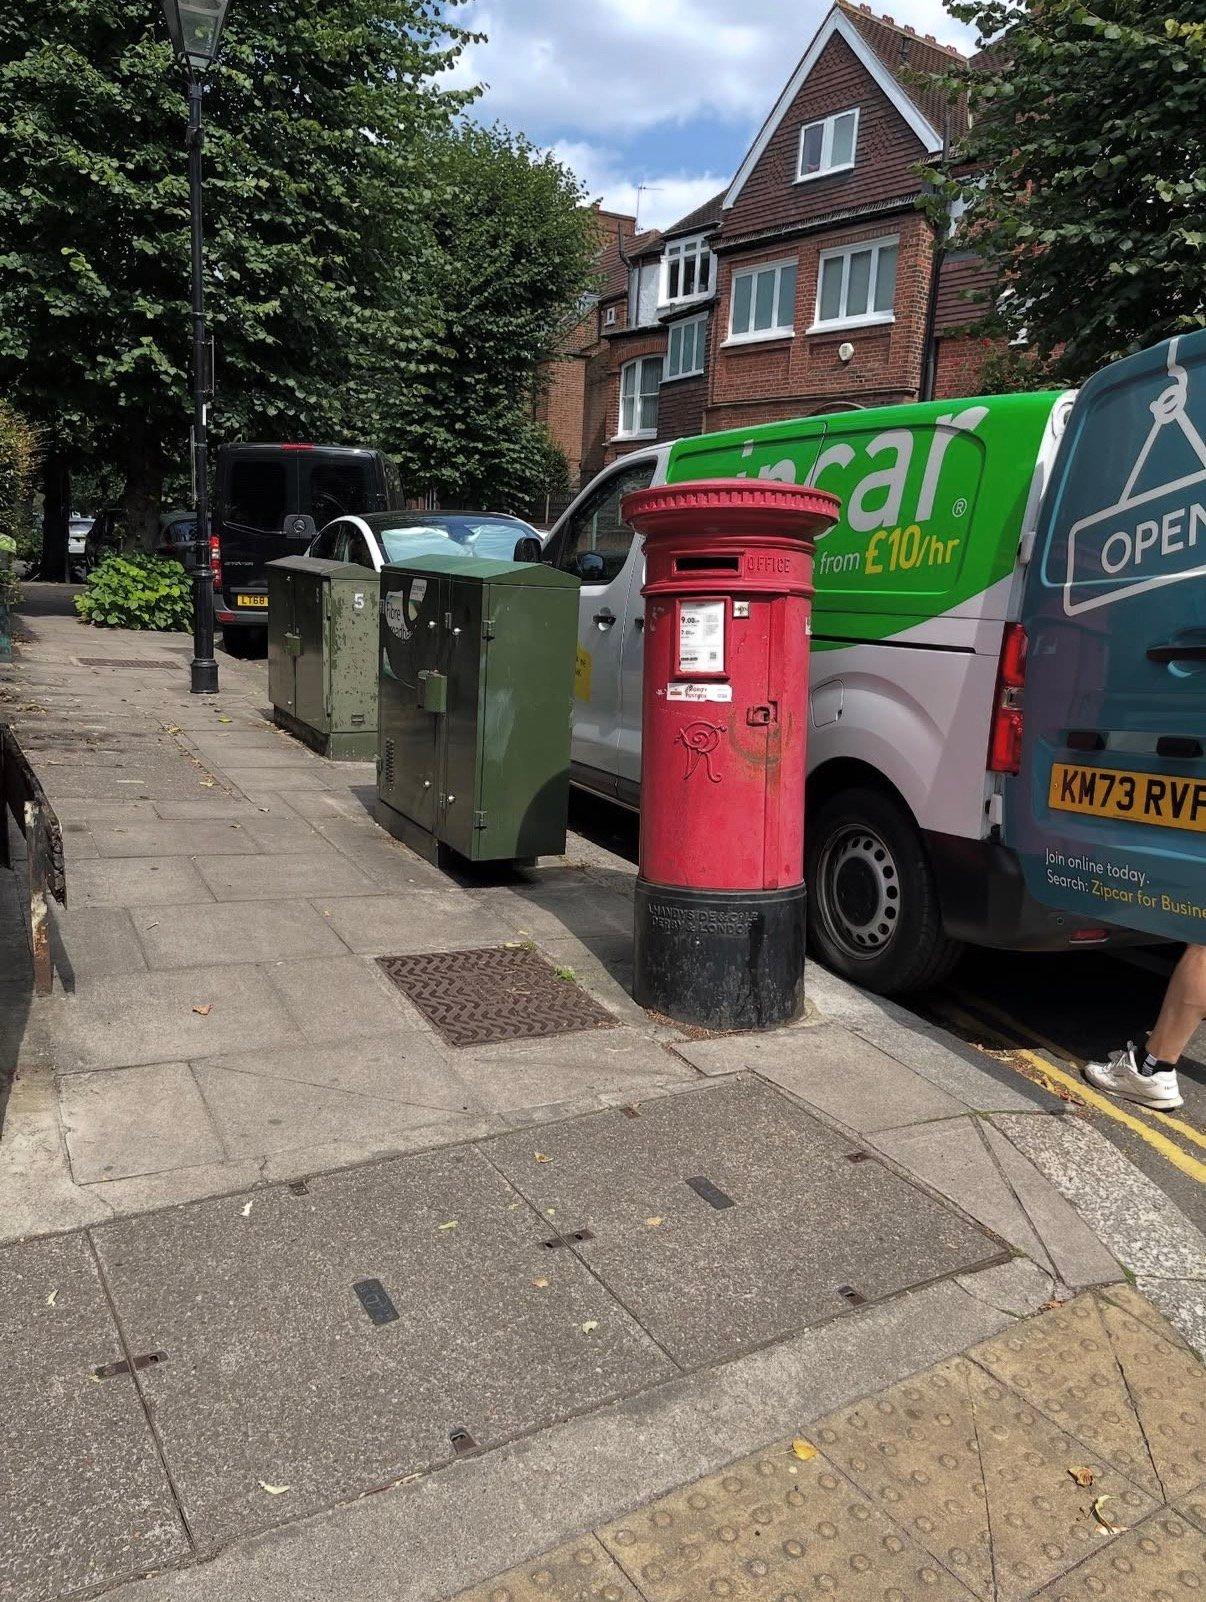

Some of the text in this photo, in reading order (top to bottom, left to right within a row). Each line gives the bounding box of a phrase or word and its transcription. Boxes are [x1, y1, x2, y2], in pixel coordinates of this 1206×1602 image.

[746, 555, 791, 574] OFFICE
[820, 552, 860, 575] from
[865, 525, 960, 575] £10/hr
[353, 593, 365, 610] 5
[1060, 769, 1136, 811] KM73
[1046, 848, 1151, 887] Join online today.
[1047, 869, 1089, 893] Search:
[1091, 879, 1134, 903] Zipcar
[1138, 890, 1157, 908] for
